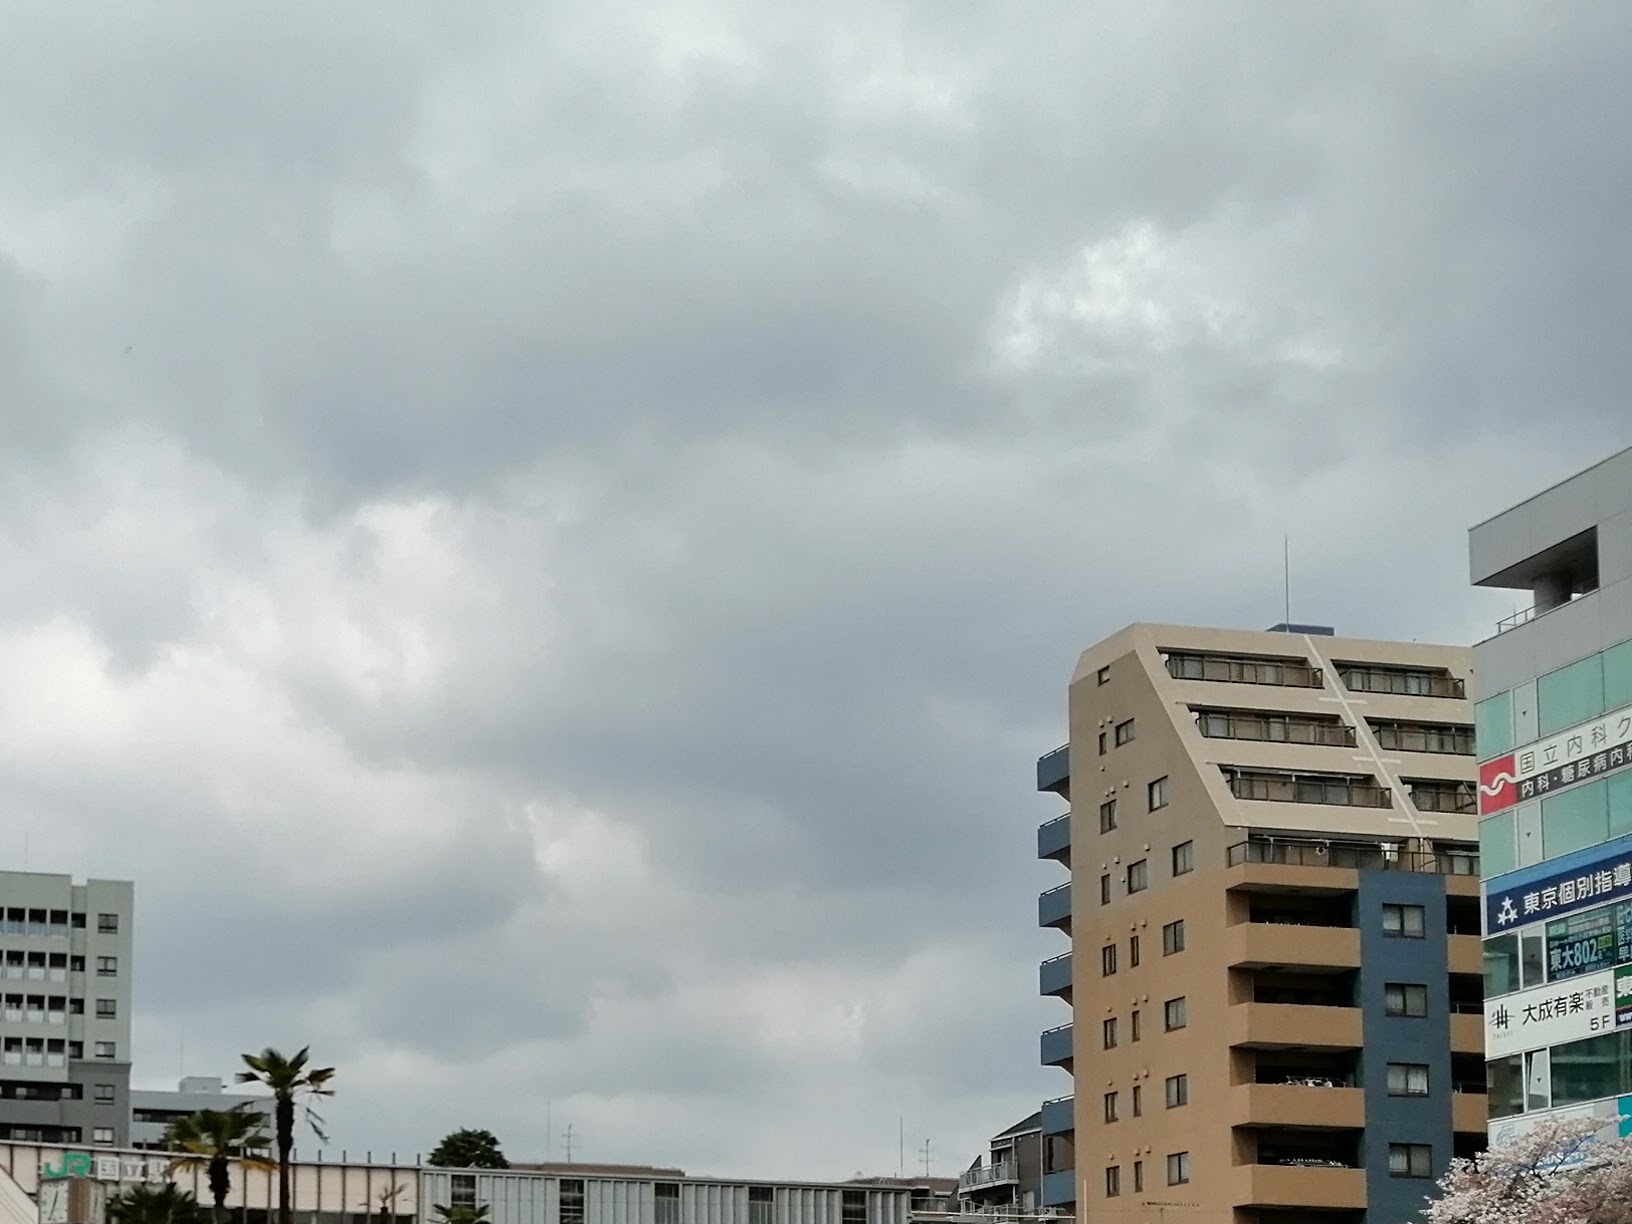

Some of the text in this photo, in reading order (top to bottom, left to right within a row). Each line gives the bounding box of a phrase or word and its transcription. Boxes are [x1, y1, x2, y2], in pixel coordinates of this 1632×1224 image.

[1523, 862, 1632, 915] 東京個別指導
[1522, 992, 1584, 1026] 大成有楽
[1590, 1014, 1610, 1031] 5F
[44, 1152, 92, 1179] JR
